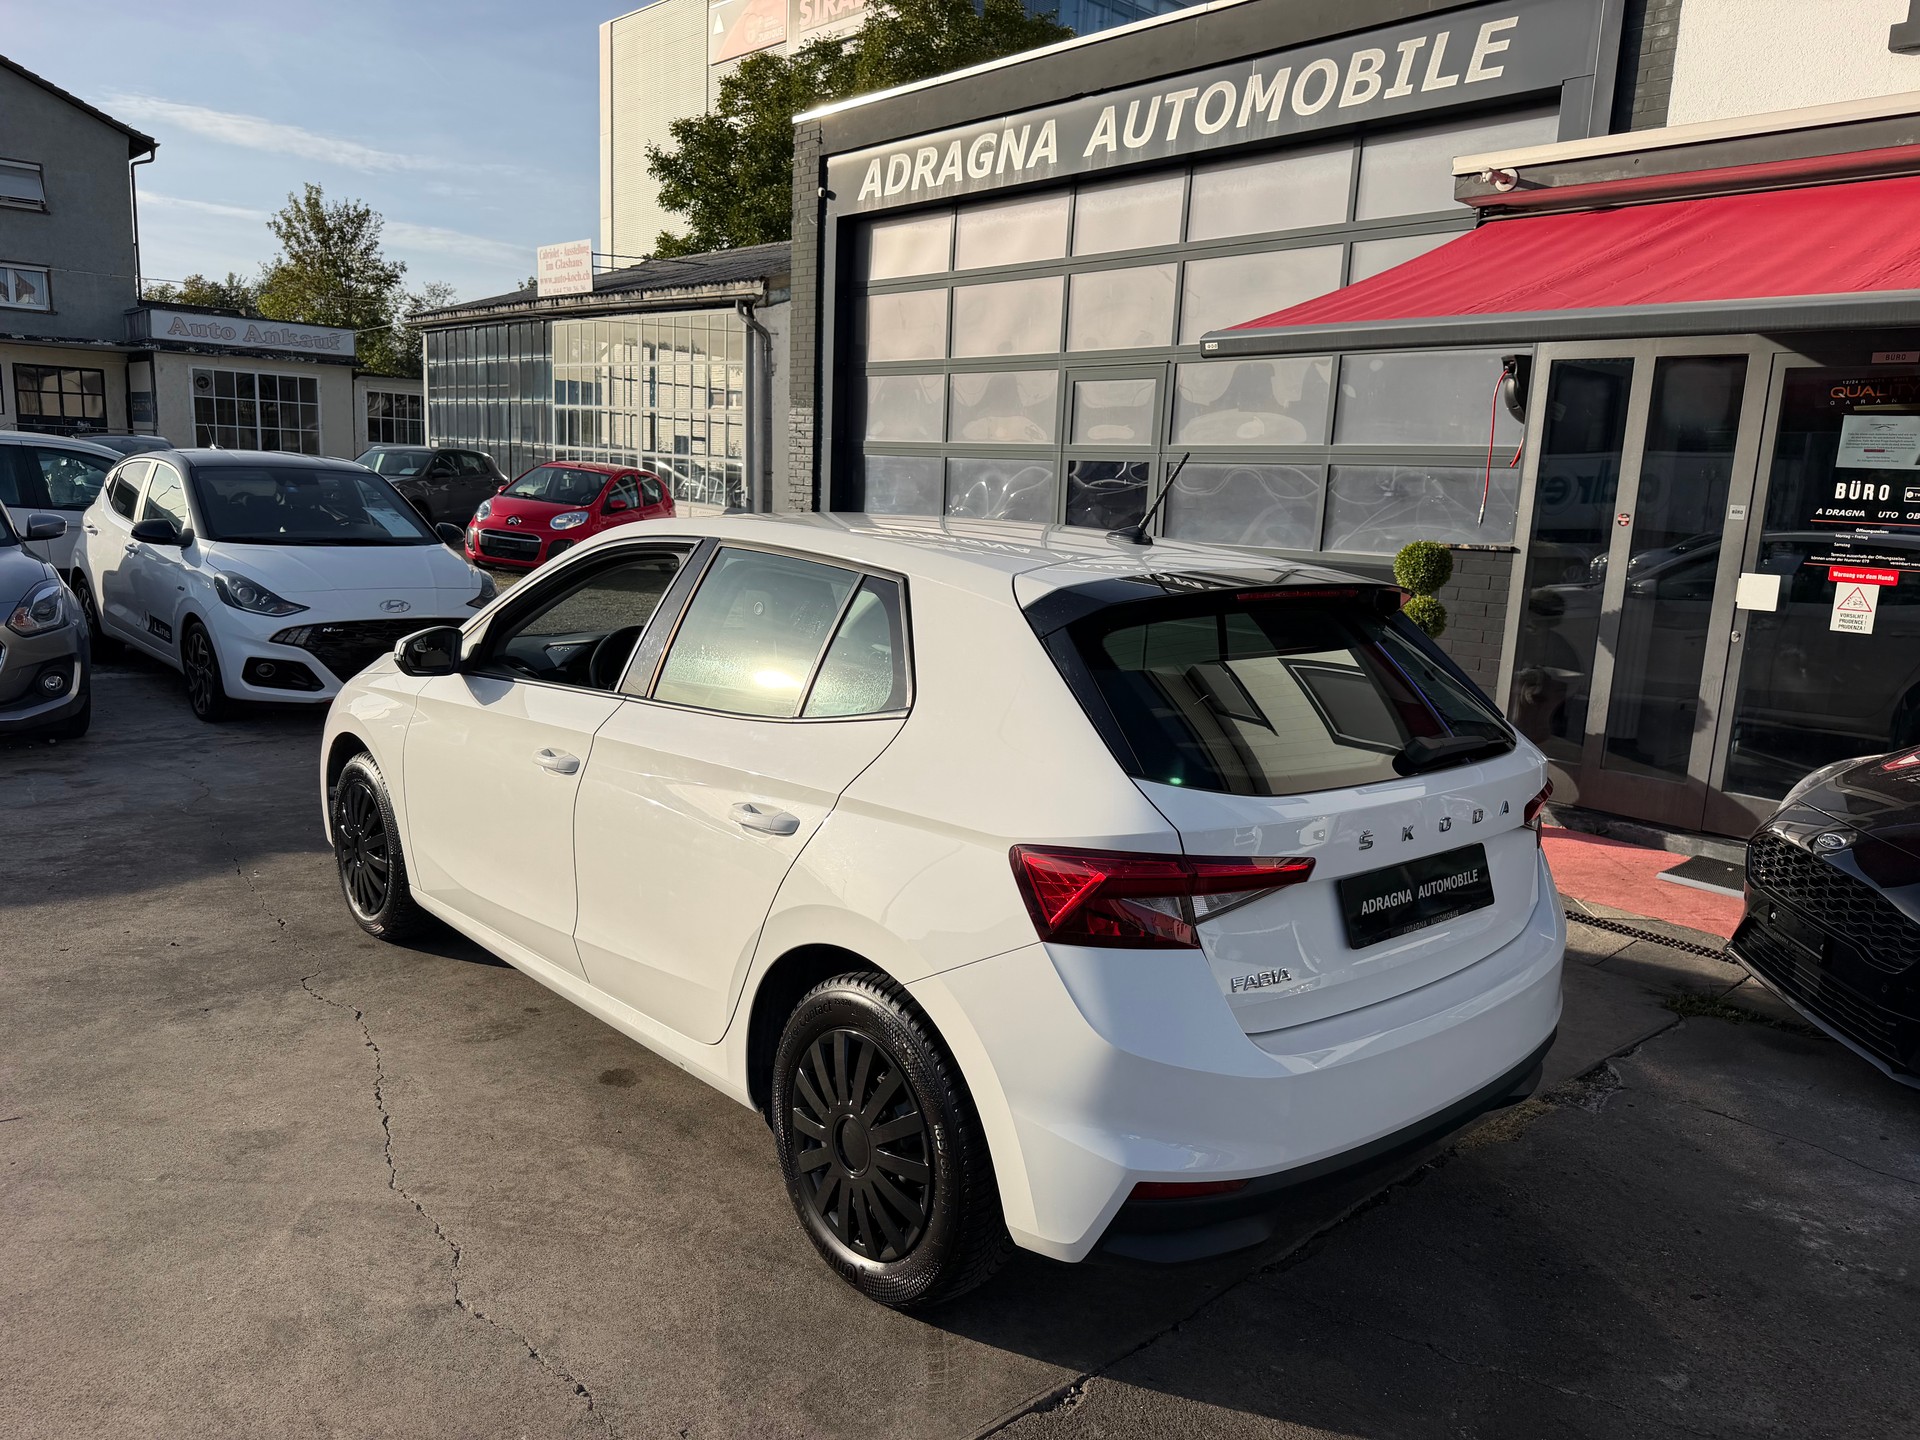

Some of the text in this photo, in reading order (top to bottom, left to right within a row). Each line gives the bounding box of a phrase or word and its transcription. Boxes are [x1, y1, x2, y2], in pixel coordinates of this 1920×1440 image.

[857, 16, 1520, 202] ADRAGNA AUTOMOBILE
[555, 258, 582, 270] Glashaus
[168, 316, 341, 350] Auto Ankauf
[1834, 480, 1890, 501] BÜRO
[1832, 571, 1855, 579] Warnung
[154, 622, 170, 639] Line
[1361, 868, 1478, 916] ADRAGNA AUTOMOBILE
[1231, 967, 1292, 993] FABIA
